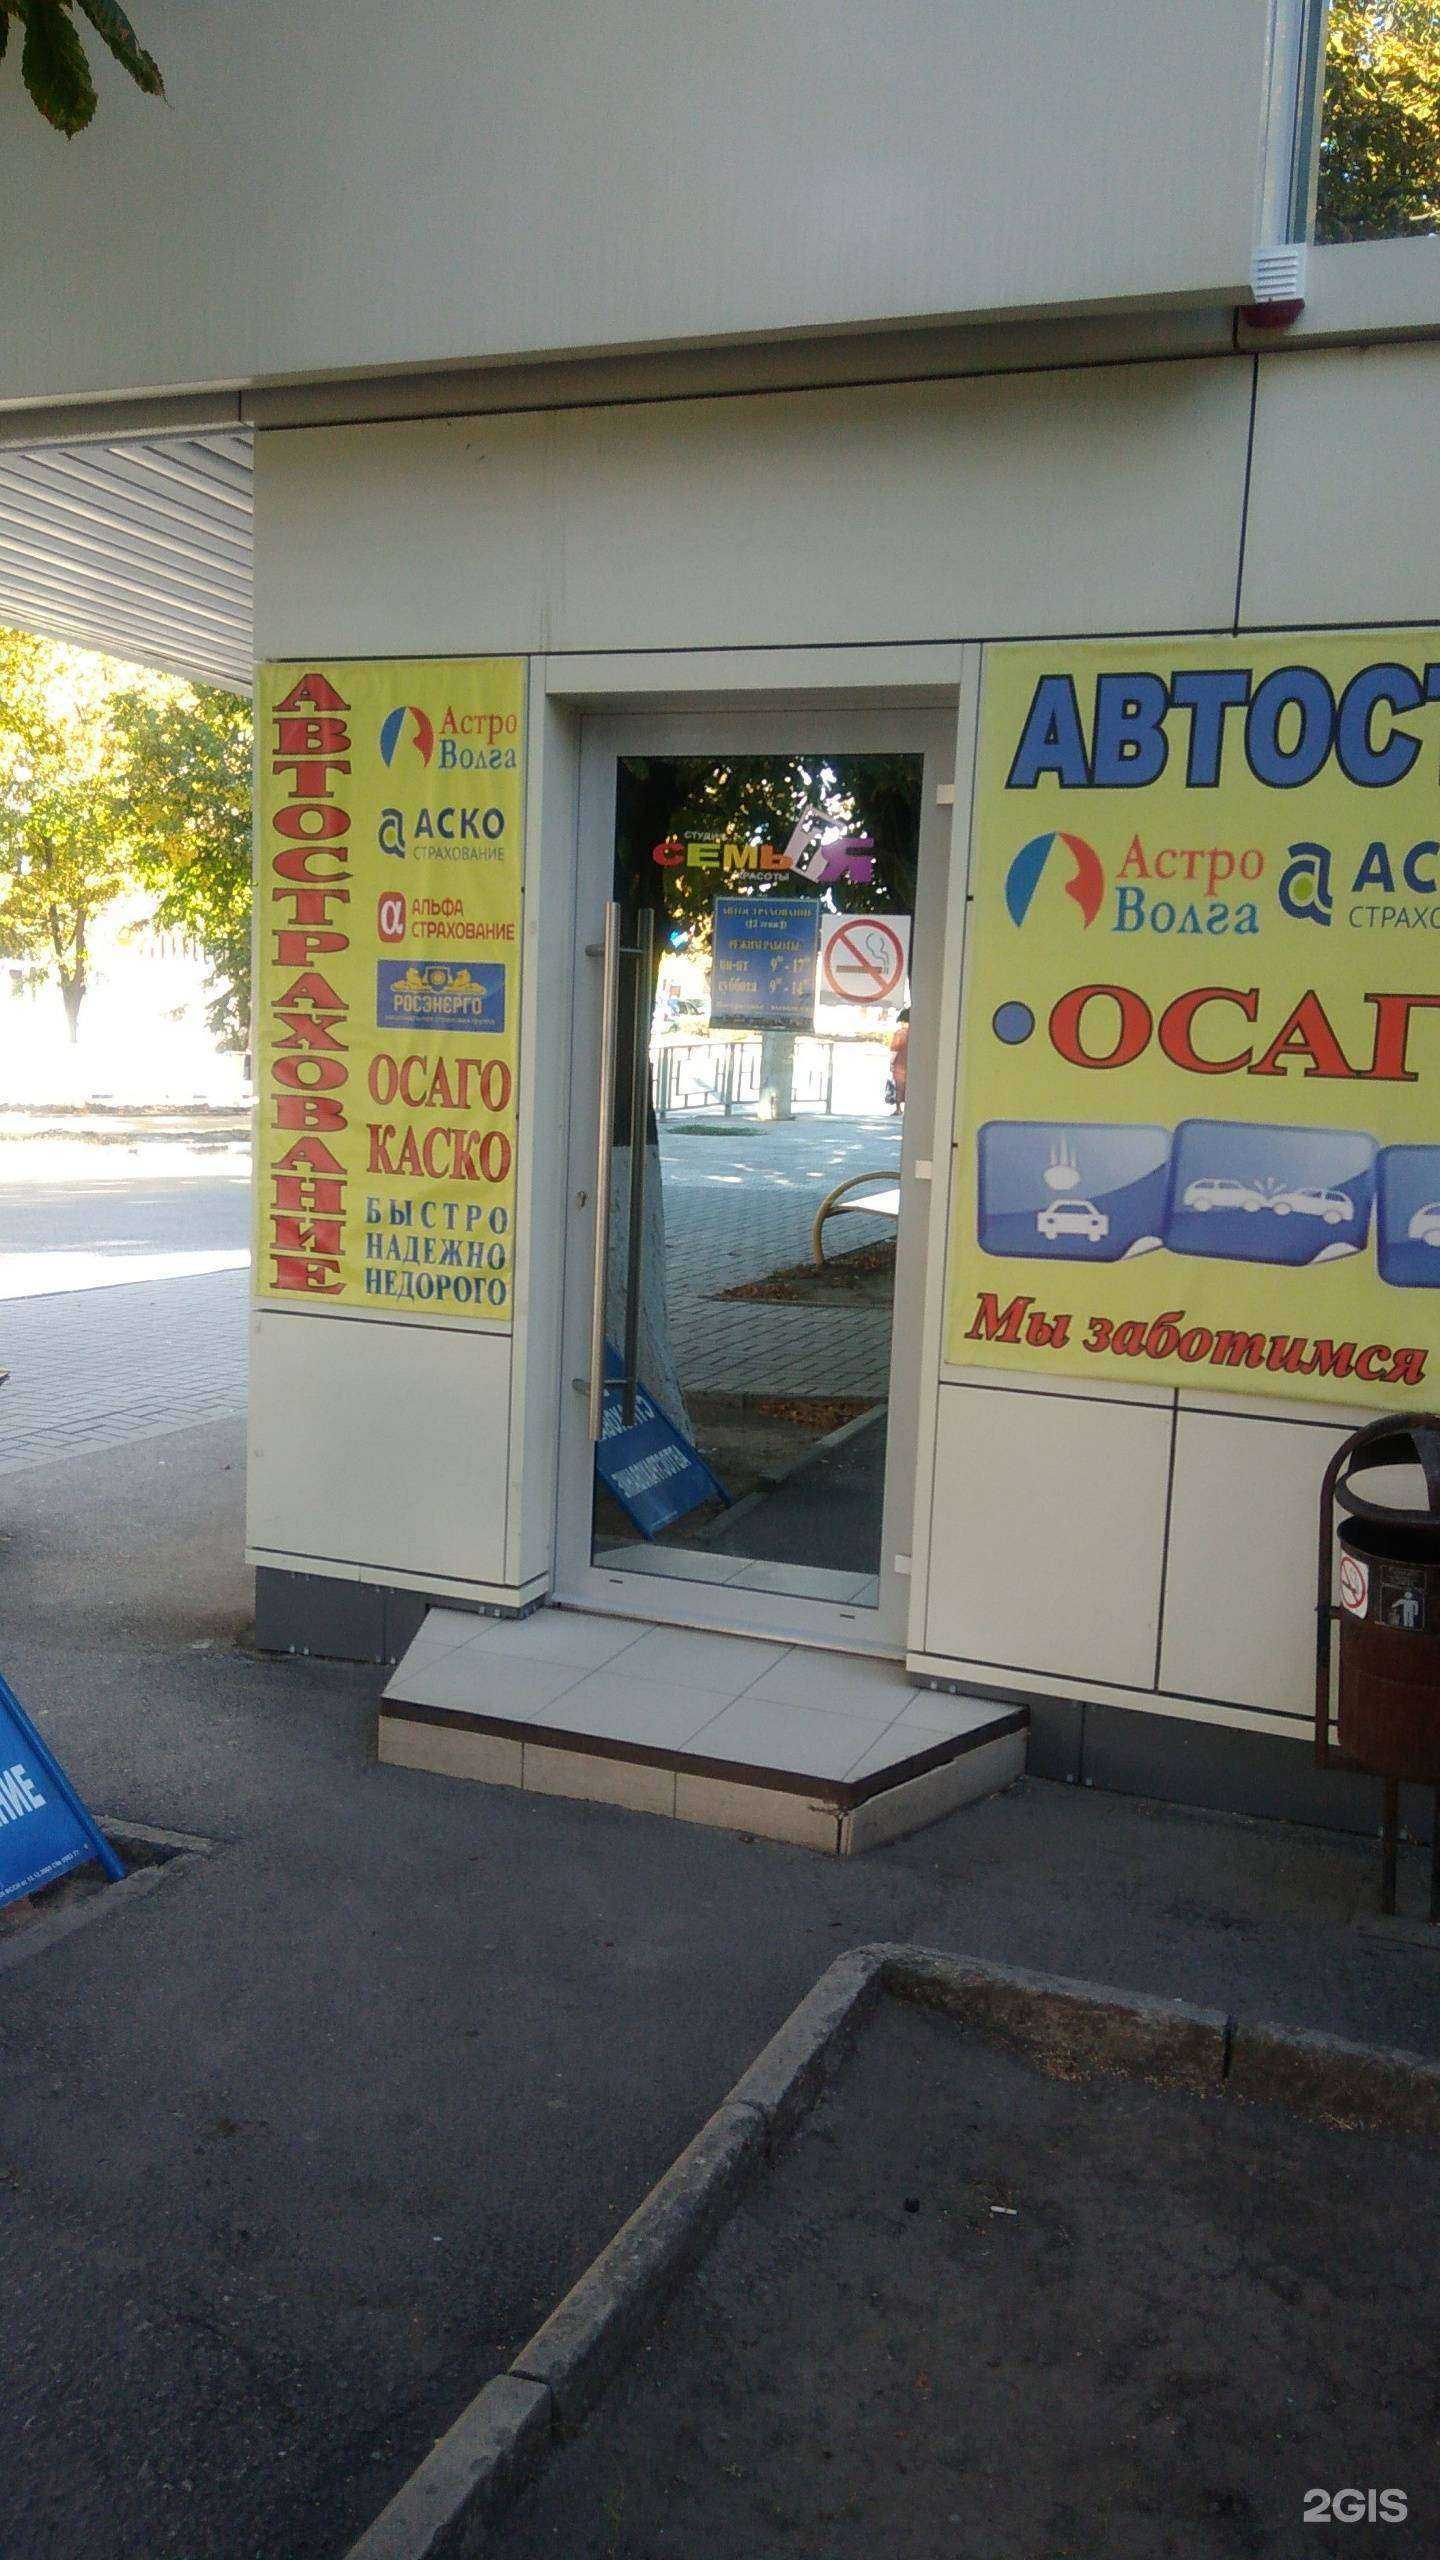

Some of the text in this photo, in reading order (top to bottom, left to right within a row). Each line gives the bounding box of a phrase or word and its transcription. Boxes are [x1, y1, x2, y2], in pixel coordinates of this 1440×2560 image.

[438, 705, 518, 745] Астро
[1004, 662, 1440, 790] АВТОС
[438, 739, 517, 770] Волга
[413, 807, 505, 840] АСКО
[412, 846, 504, 861] СТРАХОВАНИЕ
[1115, 833, 1265, 897] Астро
[412, 898, 464, 916] АЛЬФА
[1112, 886, 1261, 935] Волга
[411, 920, 515, 941] СТРАХОВАНИЕ
[269, 673, 353, 1296] АВТОСТРАХОВАНИЕ
[393, 994, 483, 1015] РОСЭНЕРГО
[367, 1053, 512, 1112] ОСАГО
[366, 1123, 512, 1183] КАСКО
[366, 1197, 508, 1234] БЫСТРО
[365, 1232, 507, 1270] НАДЕЖНО
[365, 1267, 507, 1306] НЕДОРОГО
[964, 1292, 1430, 1387] Мы заботимся
